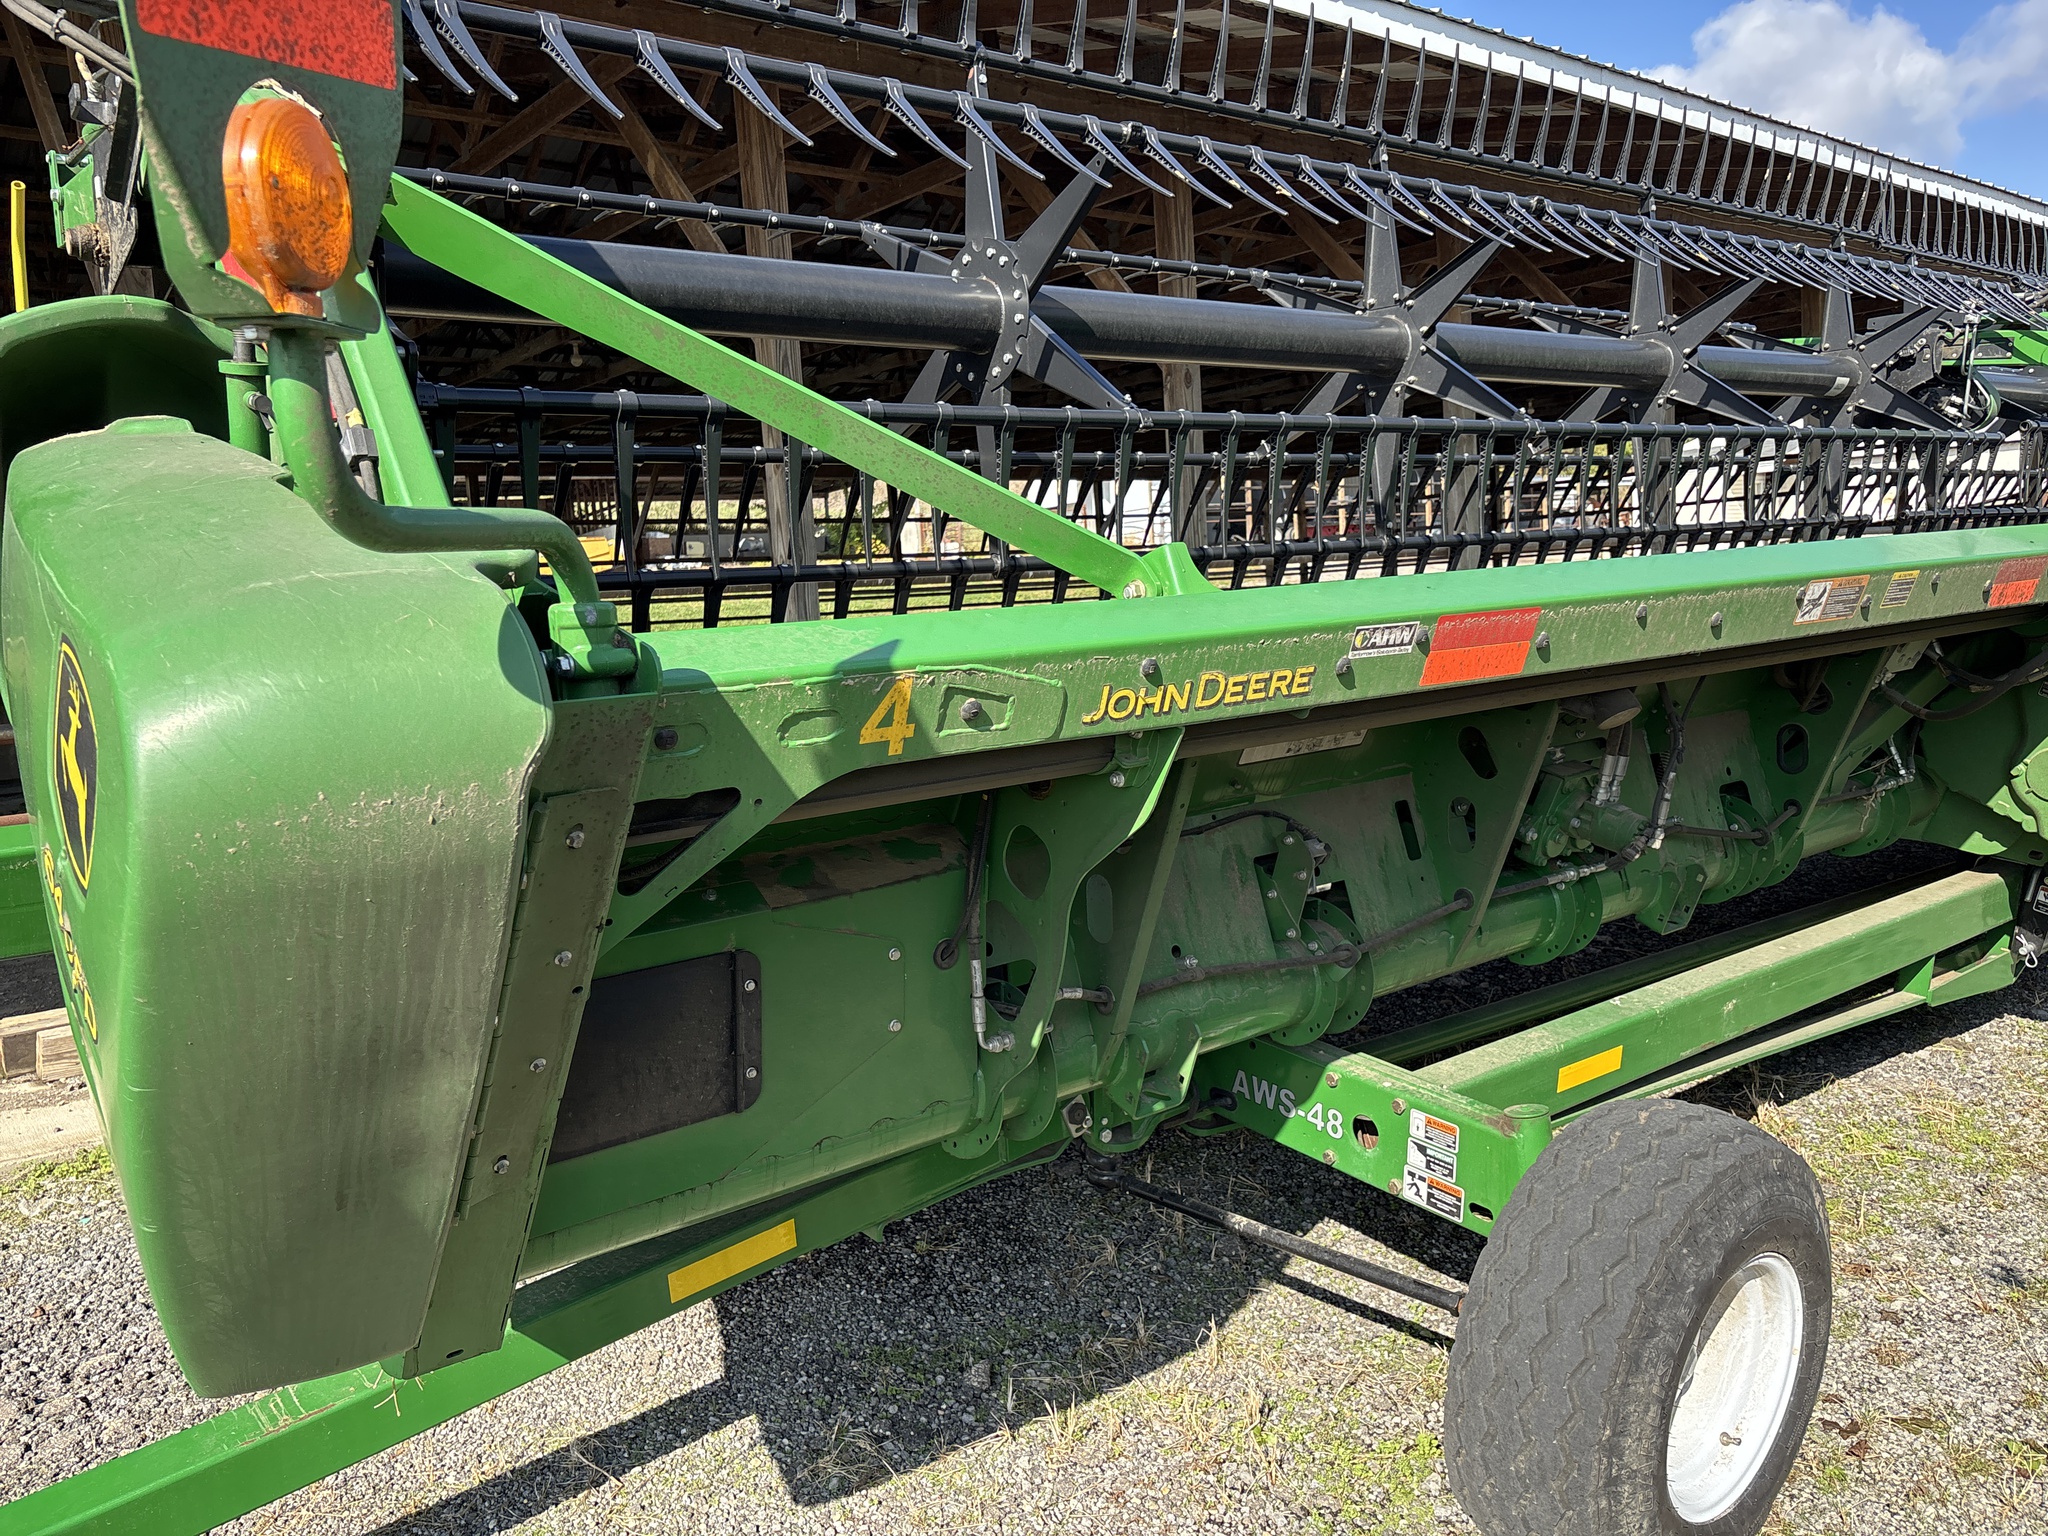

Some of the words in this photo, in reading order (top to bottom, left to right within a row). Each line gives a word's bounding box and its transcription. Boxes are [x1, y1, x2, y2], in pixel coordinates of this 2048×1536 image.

[859, 676, 916, 757] 4
[1082, 681, 1194, 726] JOHN
[1194, 665, 1317, 712] DEERE
[1231, 1069, 1344, 1139] AWS-48
[1432, 1120, 1456, 1134] WARNING
[1435, 1182, 1461, 1197] WARNING
